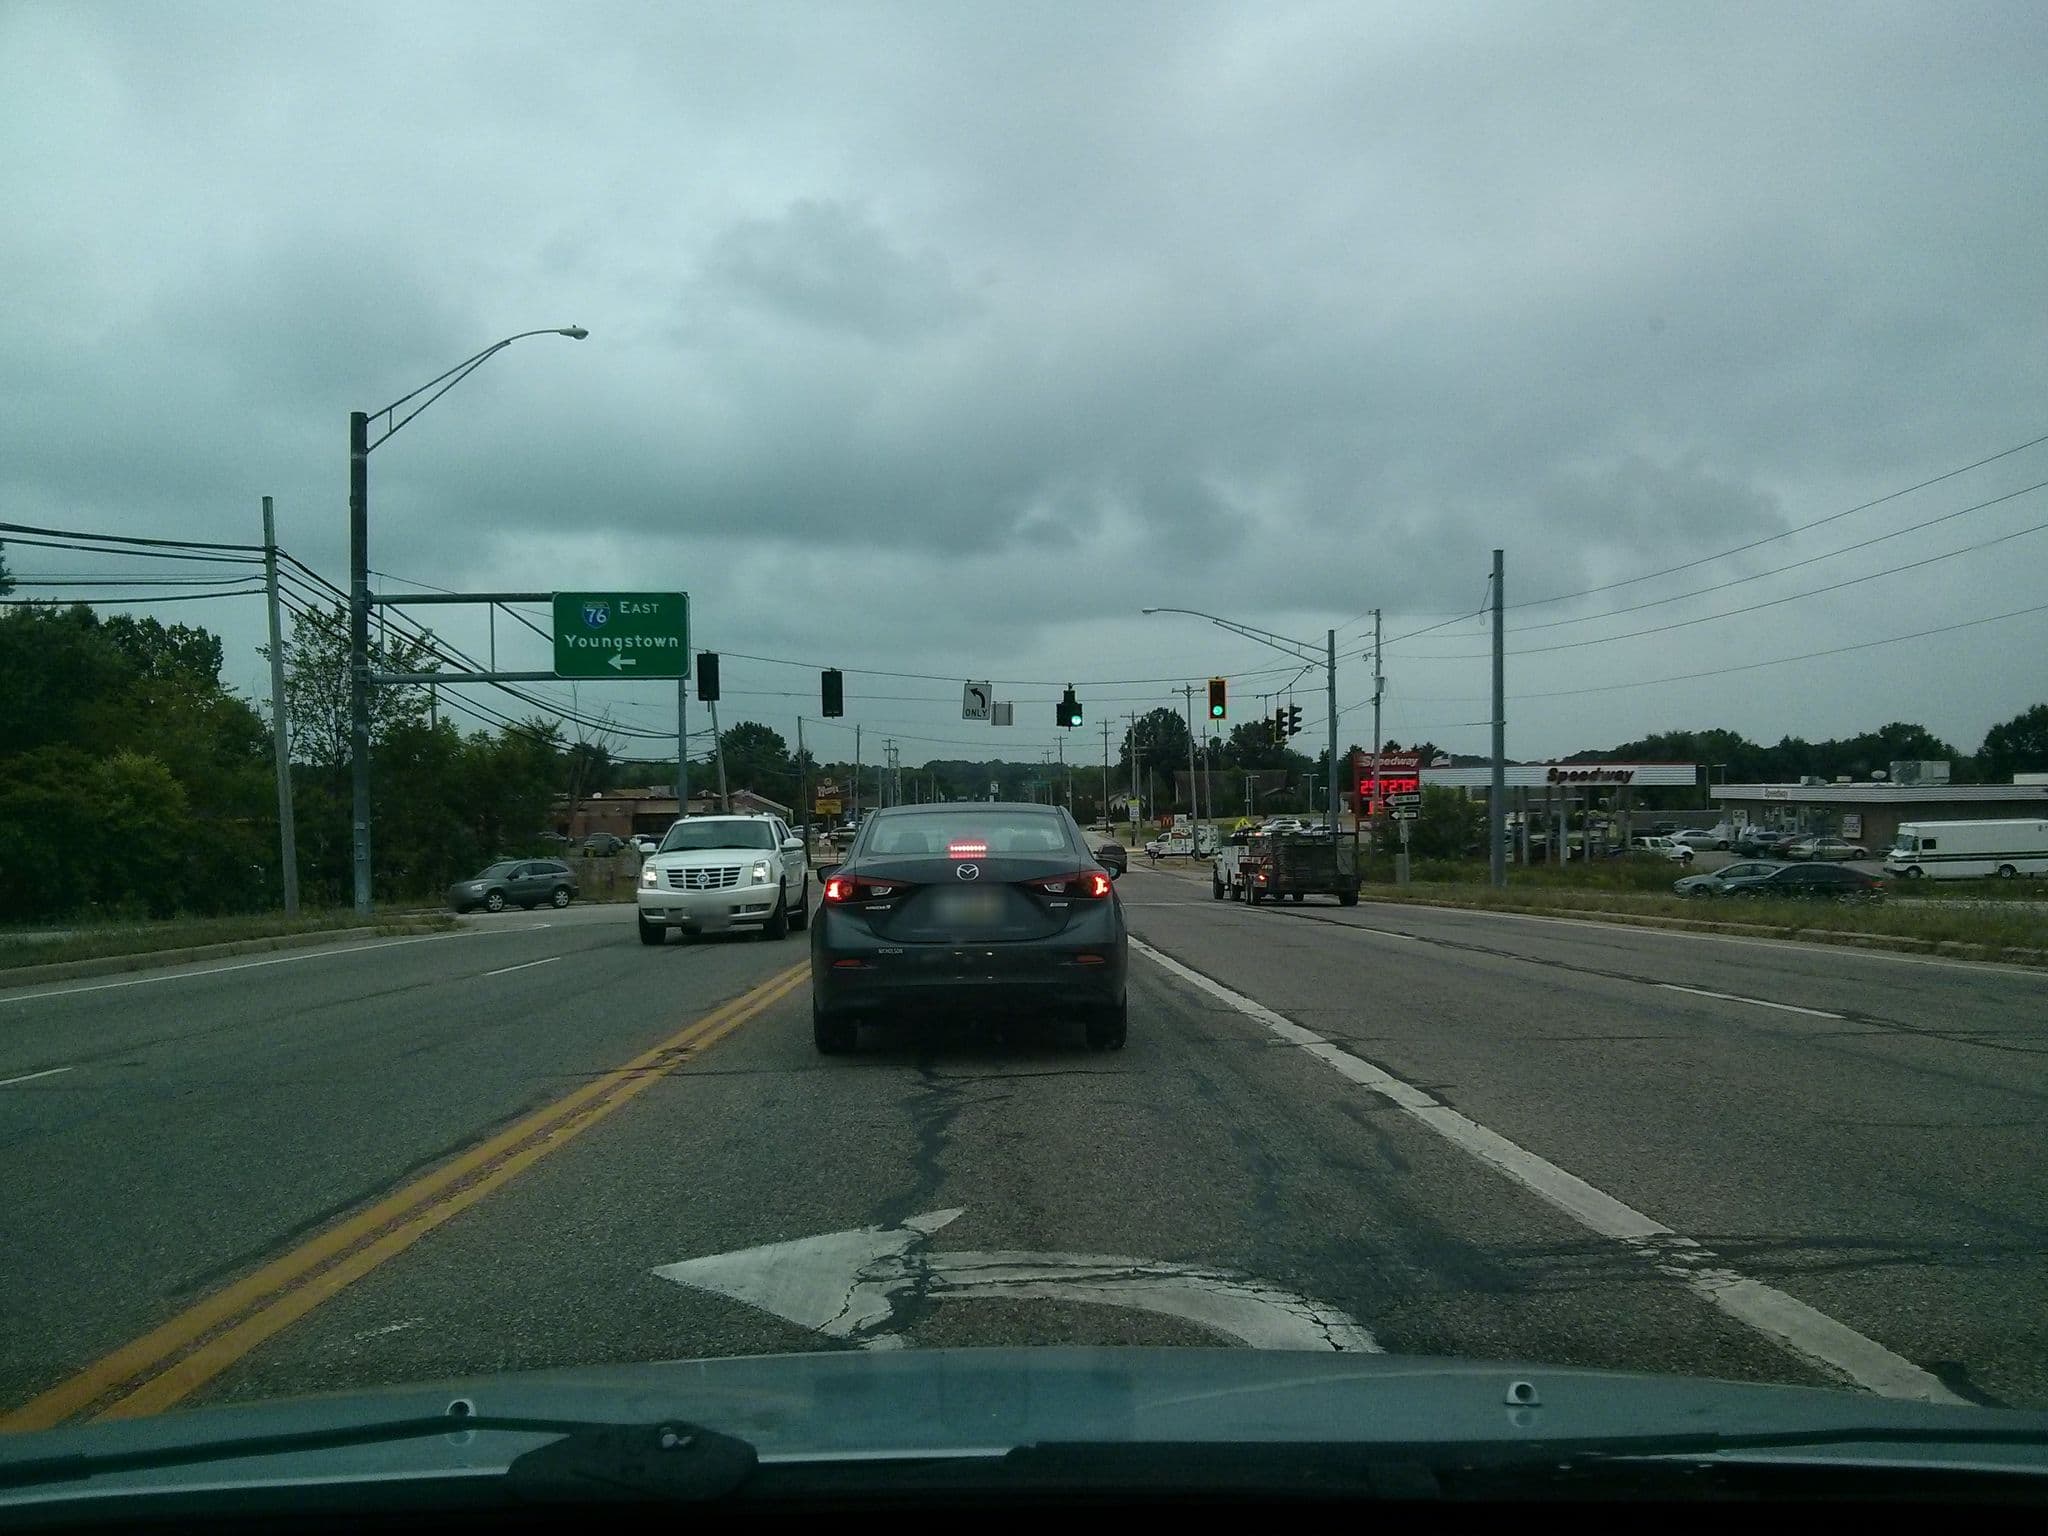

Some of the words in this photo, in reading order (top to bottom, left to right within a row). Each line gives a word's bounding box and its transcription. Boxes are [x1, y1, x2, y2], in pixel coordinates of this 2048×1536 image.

[586, 608, 607, 623] 76
[564, 634, 679, 652] Youngstown
[965, 708, 988, 718] ONLY
[1546, 767, 1635, 785] Speedway
